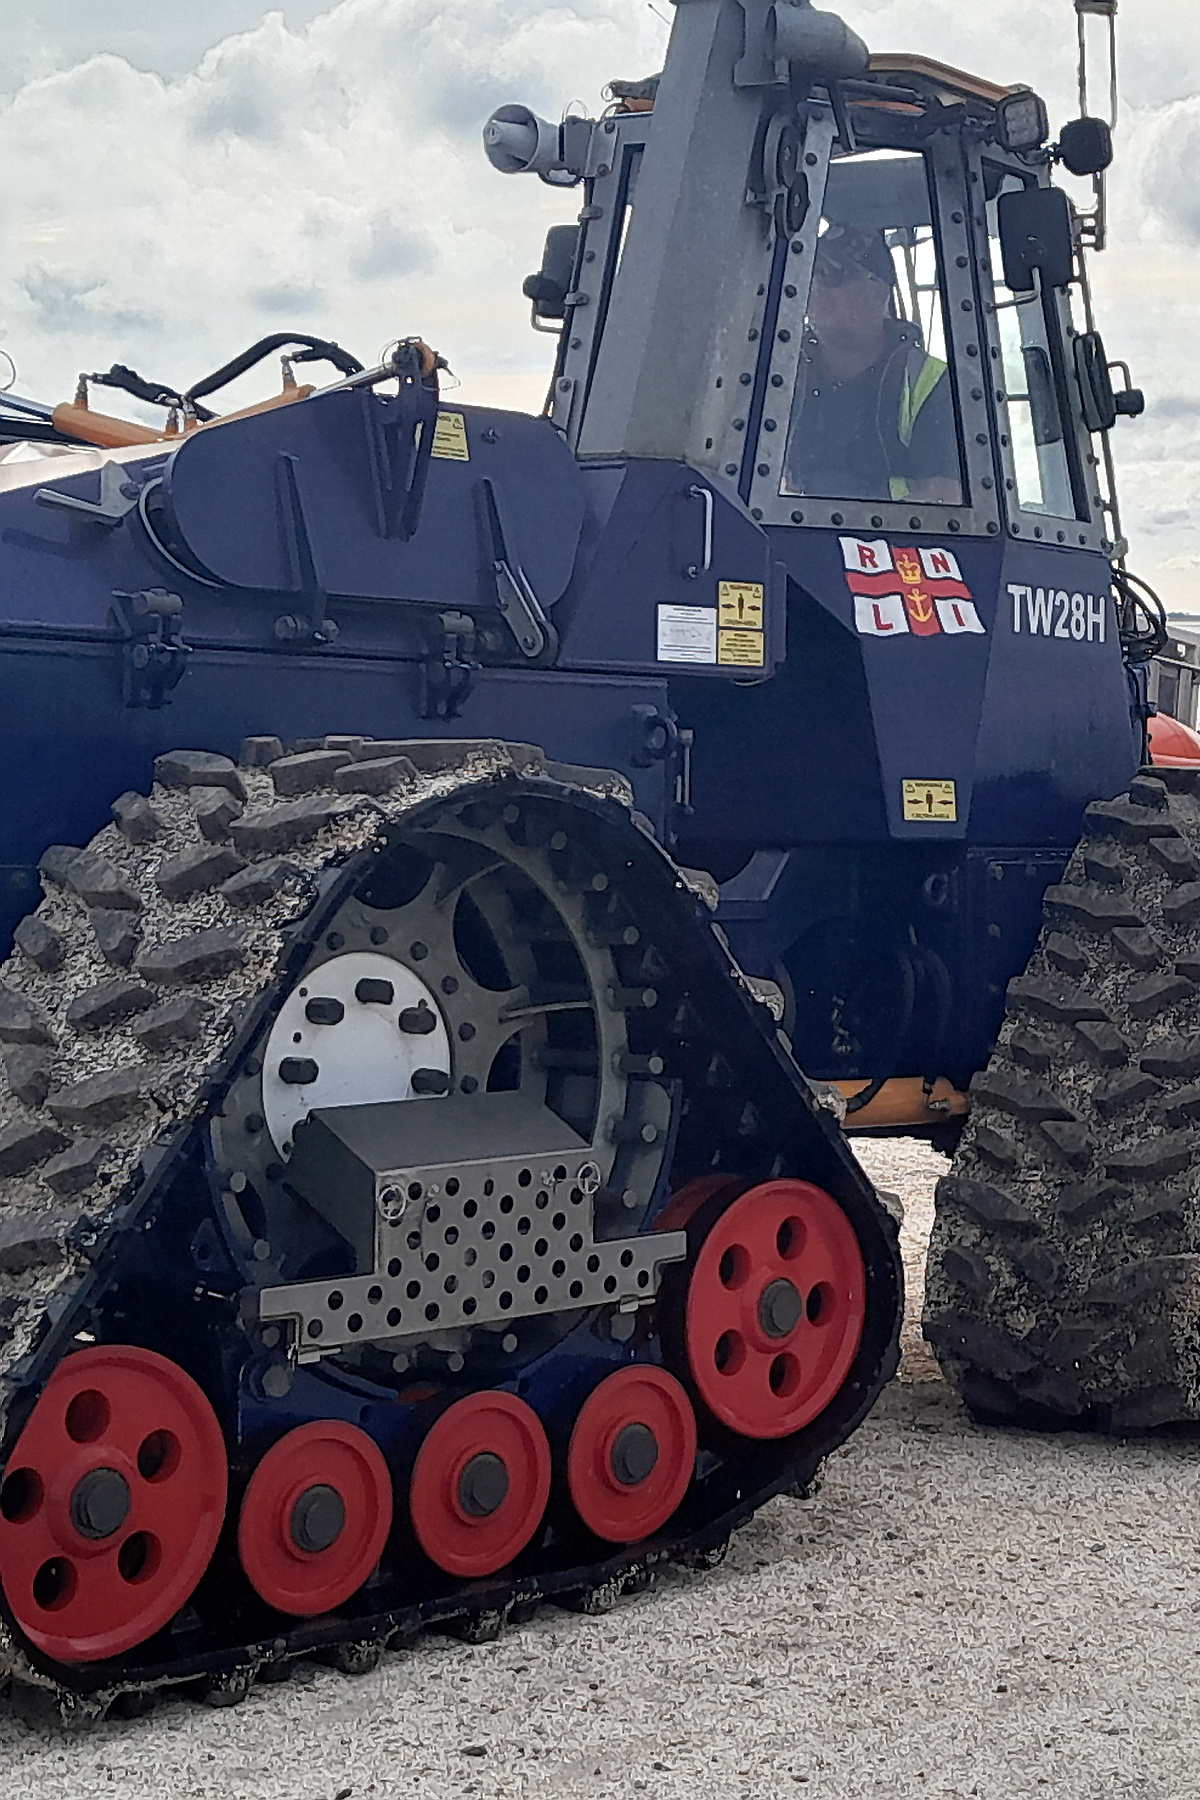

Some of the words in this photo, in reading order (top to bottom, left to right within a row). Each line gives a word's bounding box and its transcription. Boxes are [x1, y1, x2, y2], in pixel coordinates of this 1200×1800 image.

[857, 544, 879, 568] R
[931, 552, 951, 574] N
[872, 604, 894, 631] L
[951, 604, 966, 627] I
[1007, 584, 1106, 643] TW28H
